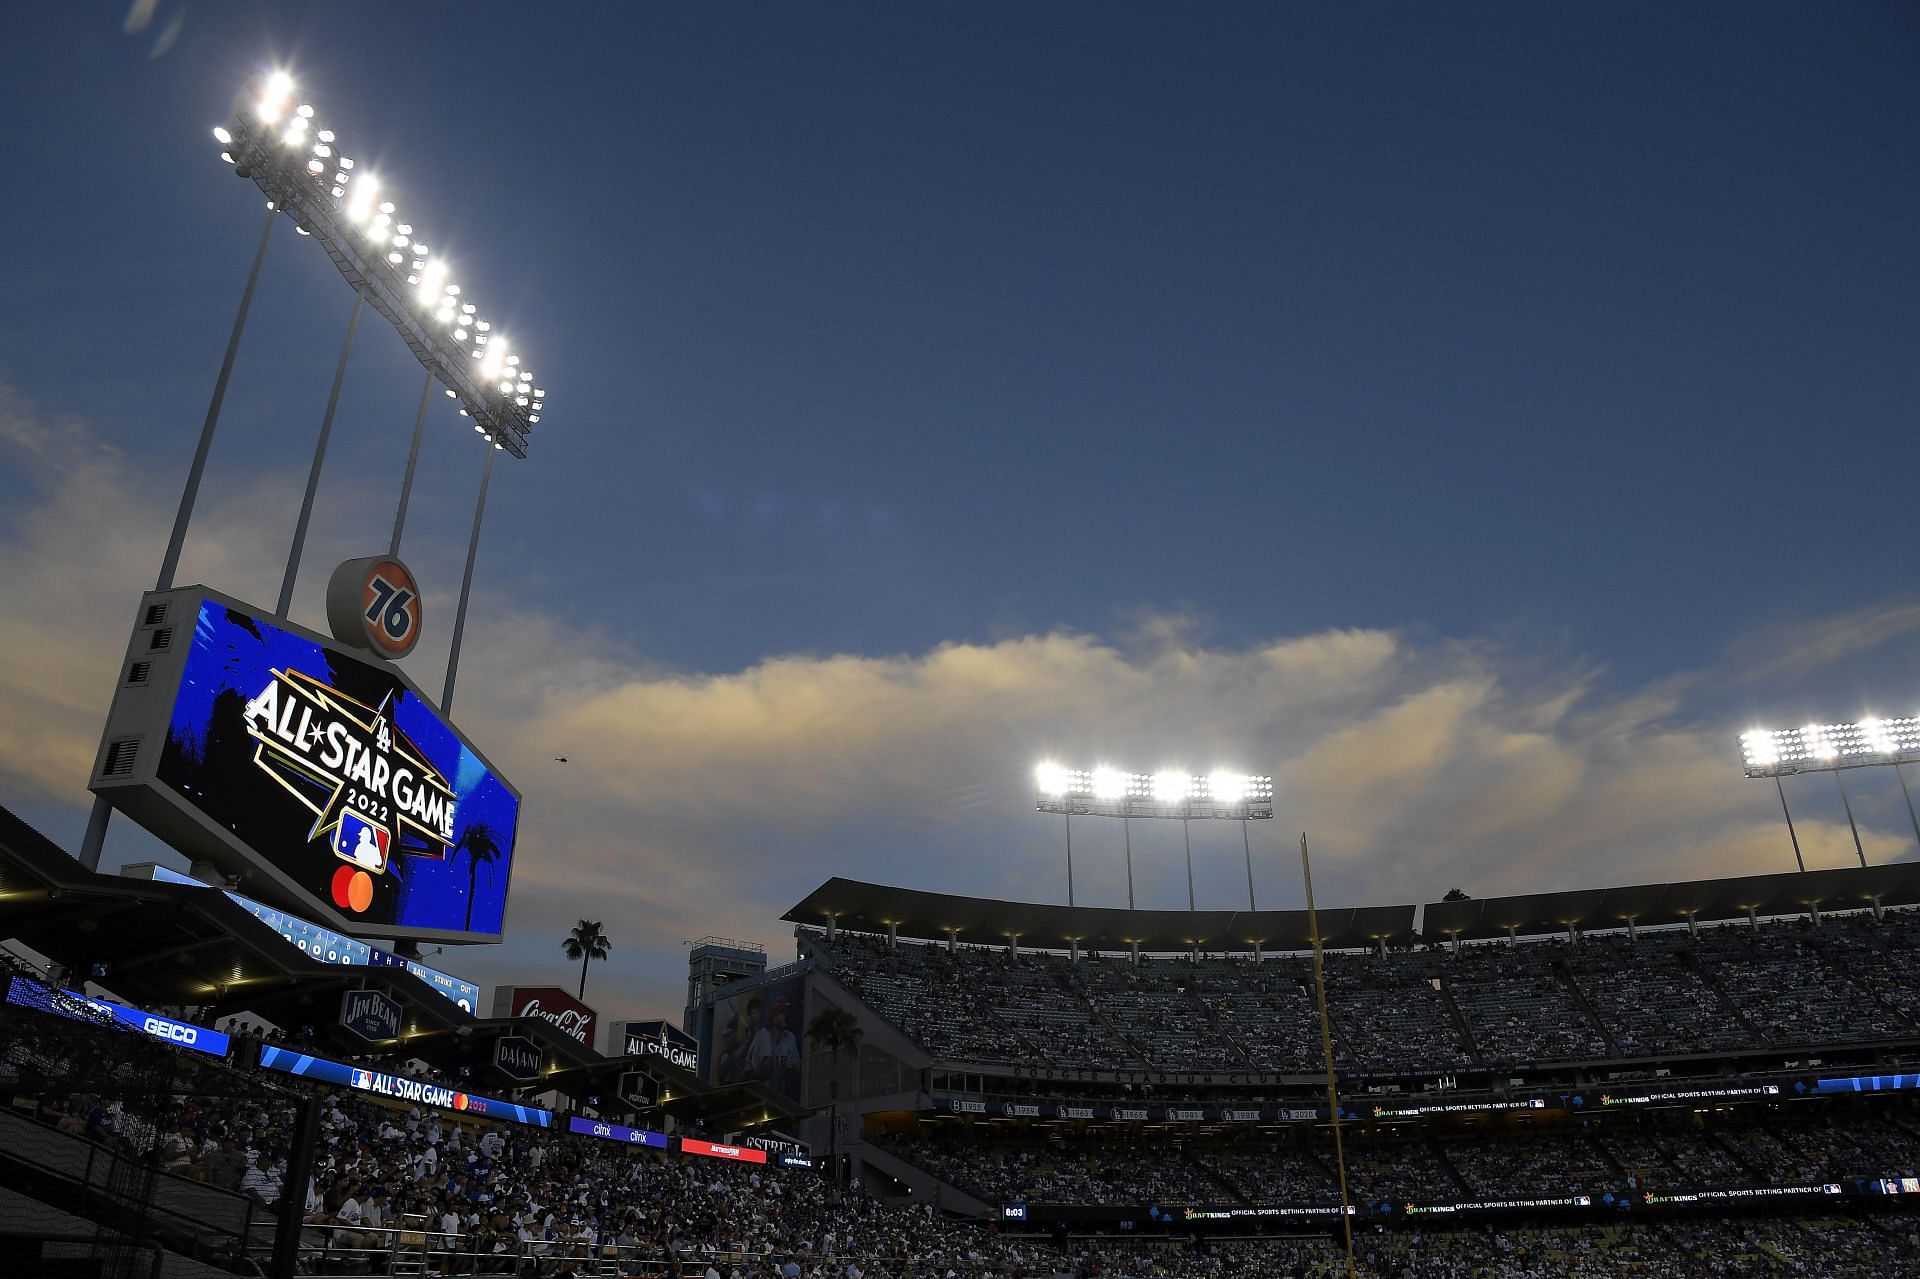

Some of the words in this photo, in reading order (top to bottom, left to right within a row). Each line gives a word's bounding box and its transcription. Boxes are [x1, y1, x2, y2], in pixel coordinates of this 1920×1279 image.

[364, 574, 416, 641] 76
[377, 715, 391, 753] LA
[346, 788, 389, 822] 2022
[392, 768, 455, 838] GAME
[287, 920, 293, 929] 4
[302, 926, 308, 935] 5
[332, 936, 338, 945] 7
[374, 951, 379, 961] R
[386, 956, 392, 965] H
[298, 940, 307, 950] 0
[312, 945, 321, 955] 0
[328, 951, 337, 961] 0
[342, 956, 351, 965] 0
[413, 967, 427, 979] BALL
[434, 975, 453, 988] STRIKE
[460, 984, 472, 994] OUT
[346, 995, 371, 1024] JIM
[371, 994, 397, 1036] BEAM
[144, 1017, 197, 1045] GEICO
[500, 1045, 539, 1071] DASANI
[670, 1048, 697, 1069] GAME
[1014, 1067, 1099, 1082] DODGER
[1114, 1072, 1213, 1085] STADIUM
[1230, 1074, 1283, 1084] CLUB
[373, 1073, 393, 1095] ALL
[395, 1078, 421, 1102] STAR
[422, 1084, 454, 1108] GAME
[468, 1100, 487, 1113] 2022
[629, 1093, 650, 1105] MORTON
[1601, 1097, 1649, 1106] DRAFTKINGS
[965, 1103, 982, 1111] 1955
[1017, 1107, 1035, 1116] 1959
[1125, 1110, 1143, 1119] 1965
[1181, 1111, 1199, 1119] 1981
[1295, 1110, 1314, 1119] 2020
[1373, 1108, 1419, 1118] DRAFTKINGS
[593, 1123, 611, 1137] citrix
[630, 1130, 646, 1143] citrix
[1644, 1193, 1697, 1204] DRAFTKINGS
[1729, 1189, 1753, 1197] SPORTS
[1755, 1188, 1782, 1196] BETTING
[1005, 1208, 1023, 1216] 8:03
[1184, 1209, 1230, 1220] DRAFTKINGS
[1405, 1204, 1454, 1215] DRAFTKINGS
